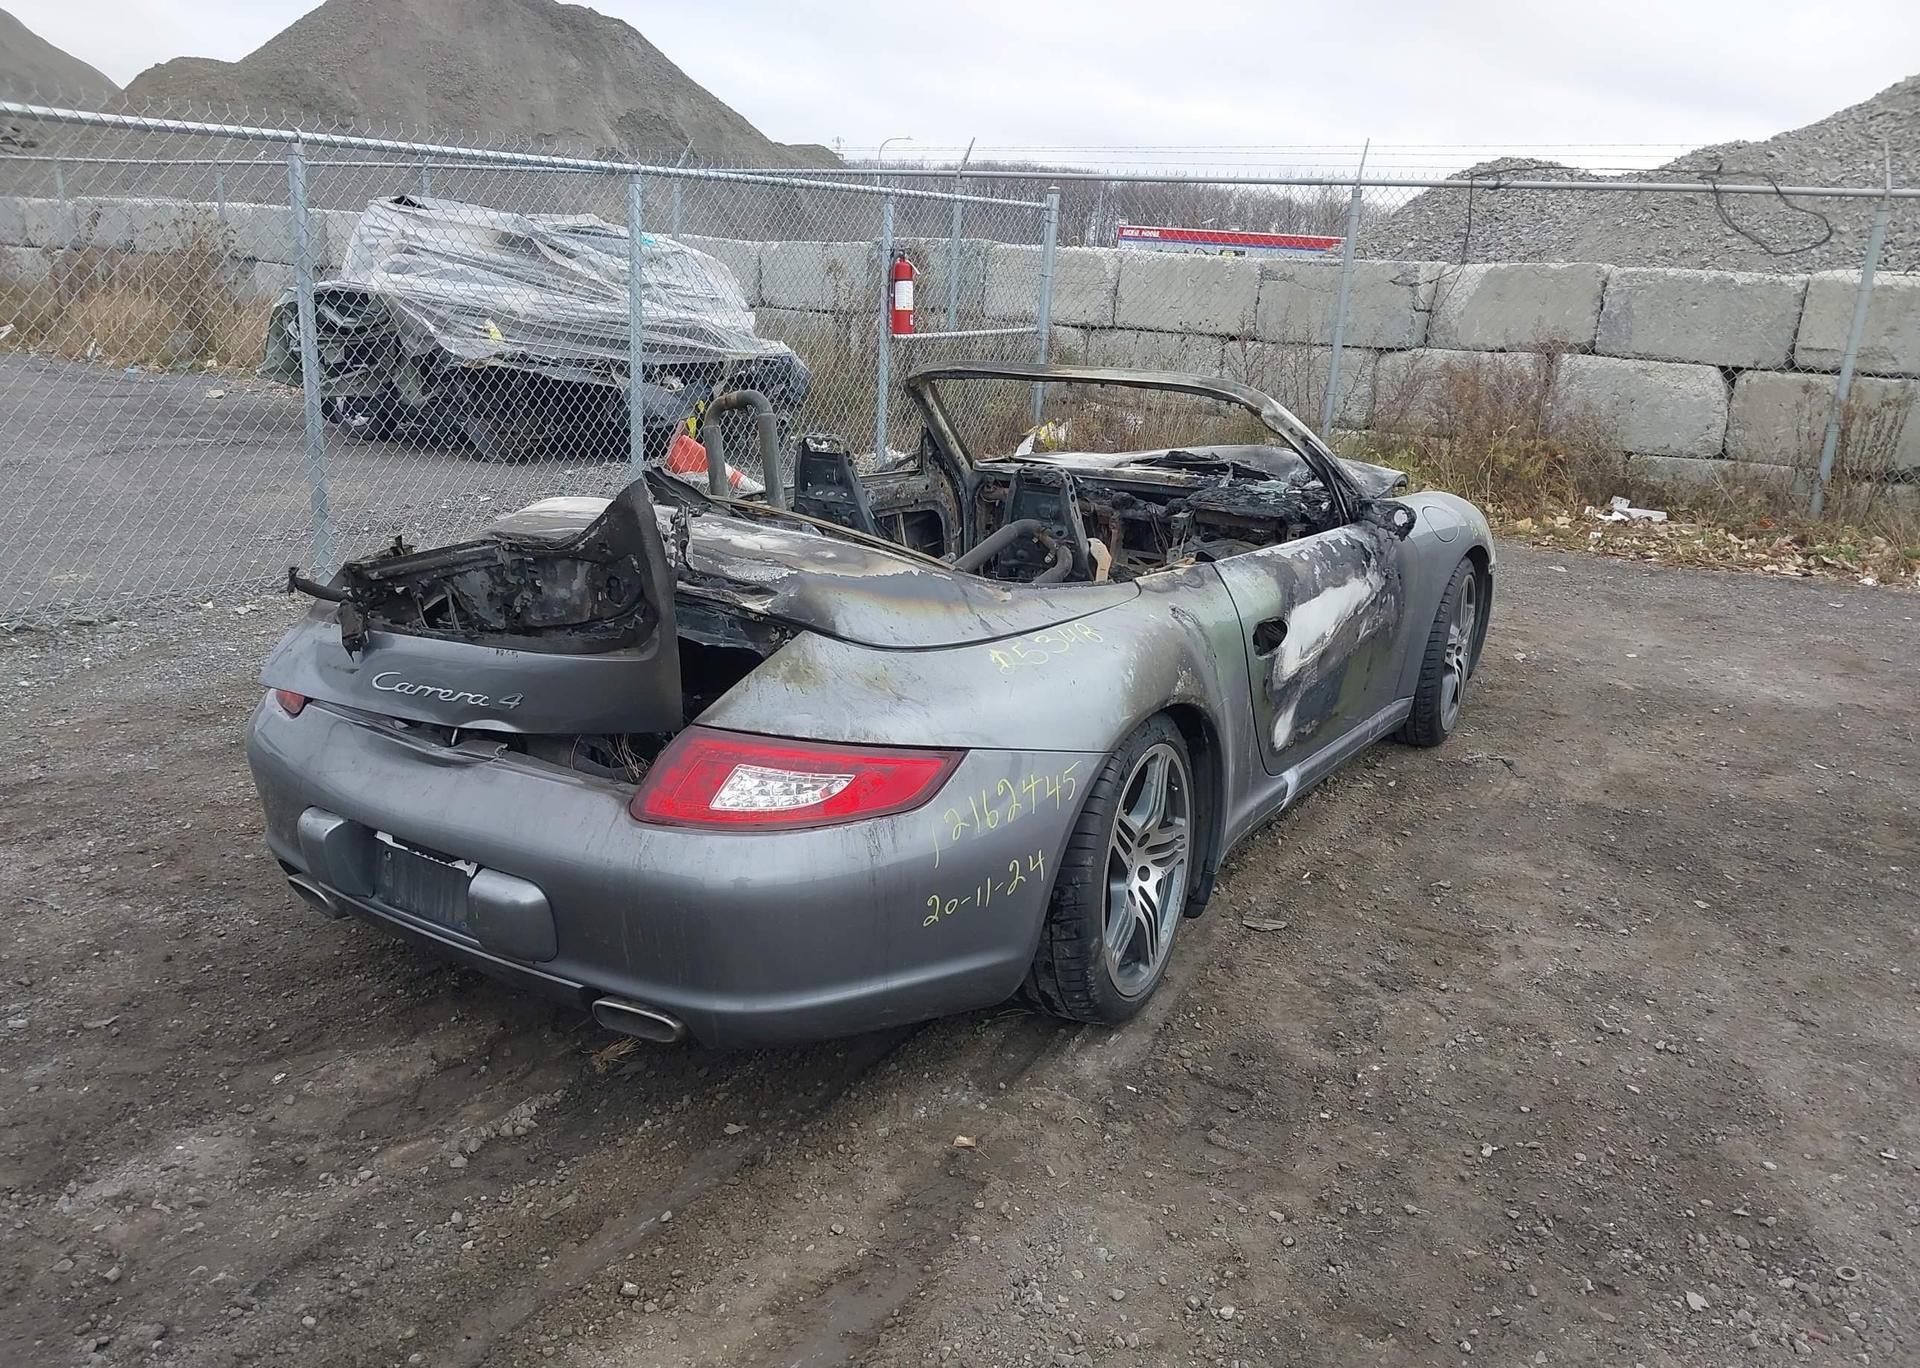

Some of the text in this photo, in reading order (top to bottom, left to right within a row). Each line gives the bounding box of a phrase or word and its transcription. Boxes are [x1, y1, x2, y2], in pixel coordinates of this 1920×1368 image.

[371, 671, 524, 710] Carrera 4
[929, 760, 1083, 869] 12162445
[922, 848, 1046, 927] 20-11-24
